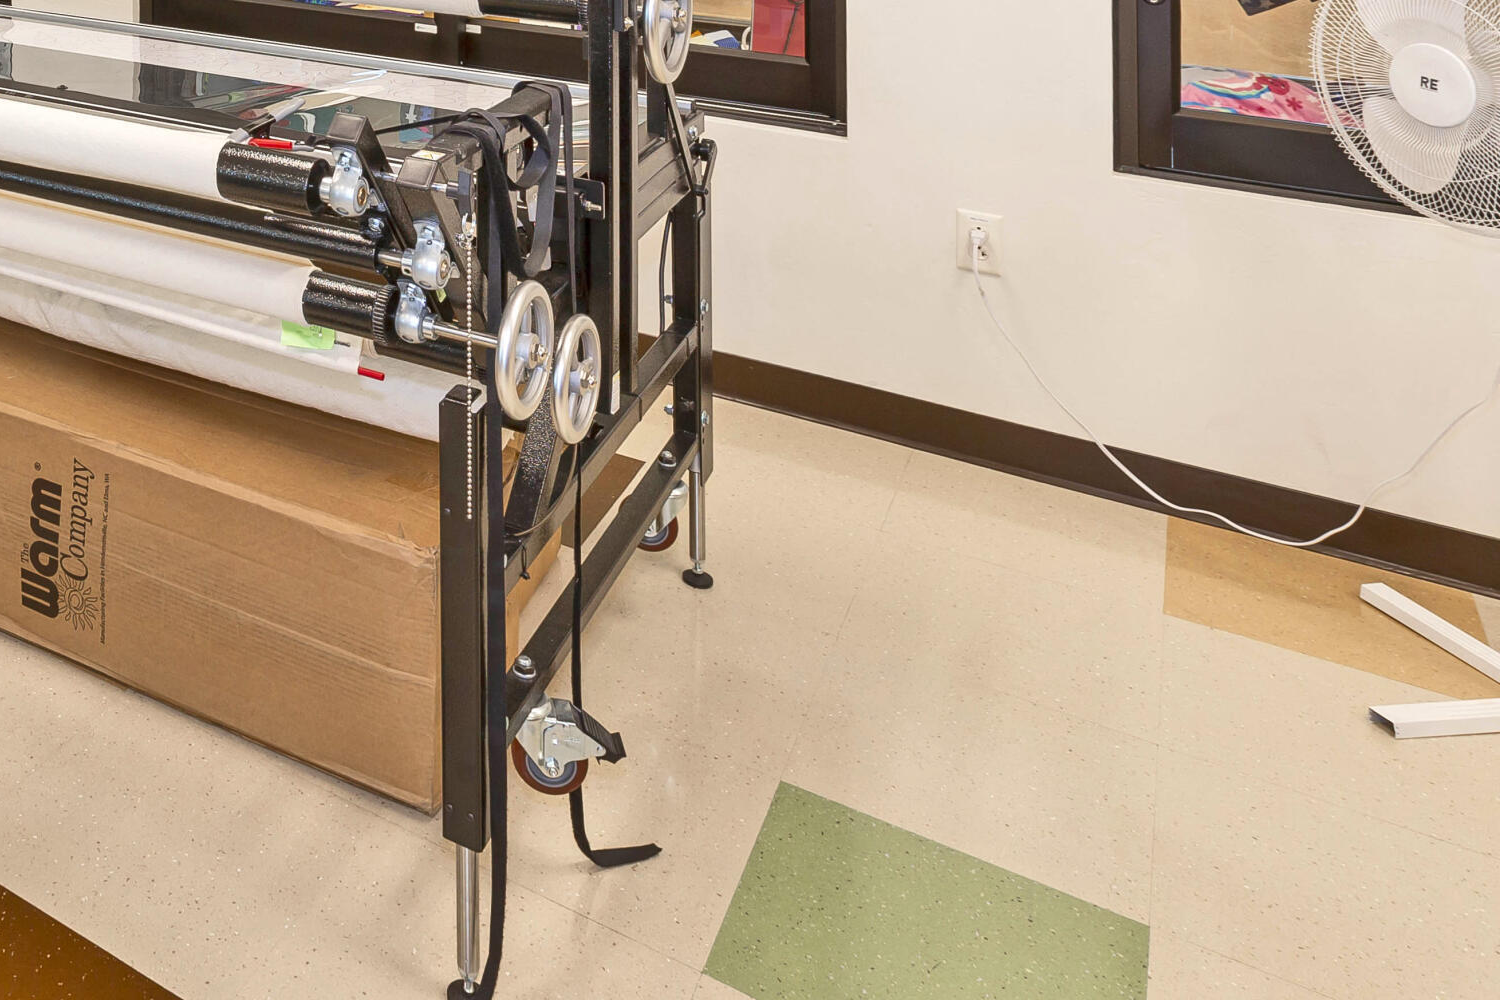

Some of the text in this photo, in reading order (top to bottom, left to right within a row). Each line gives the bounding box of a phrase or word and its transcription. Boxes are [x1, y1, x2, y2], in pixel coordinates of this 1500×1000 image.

[1420, 76, 1439, 91] RE
[20, 477, 63, 619] Warm
[20, 543, 29, 564] The
[60, 456, 95, 582] Company
